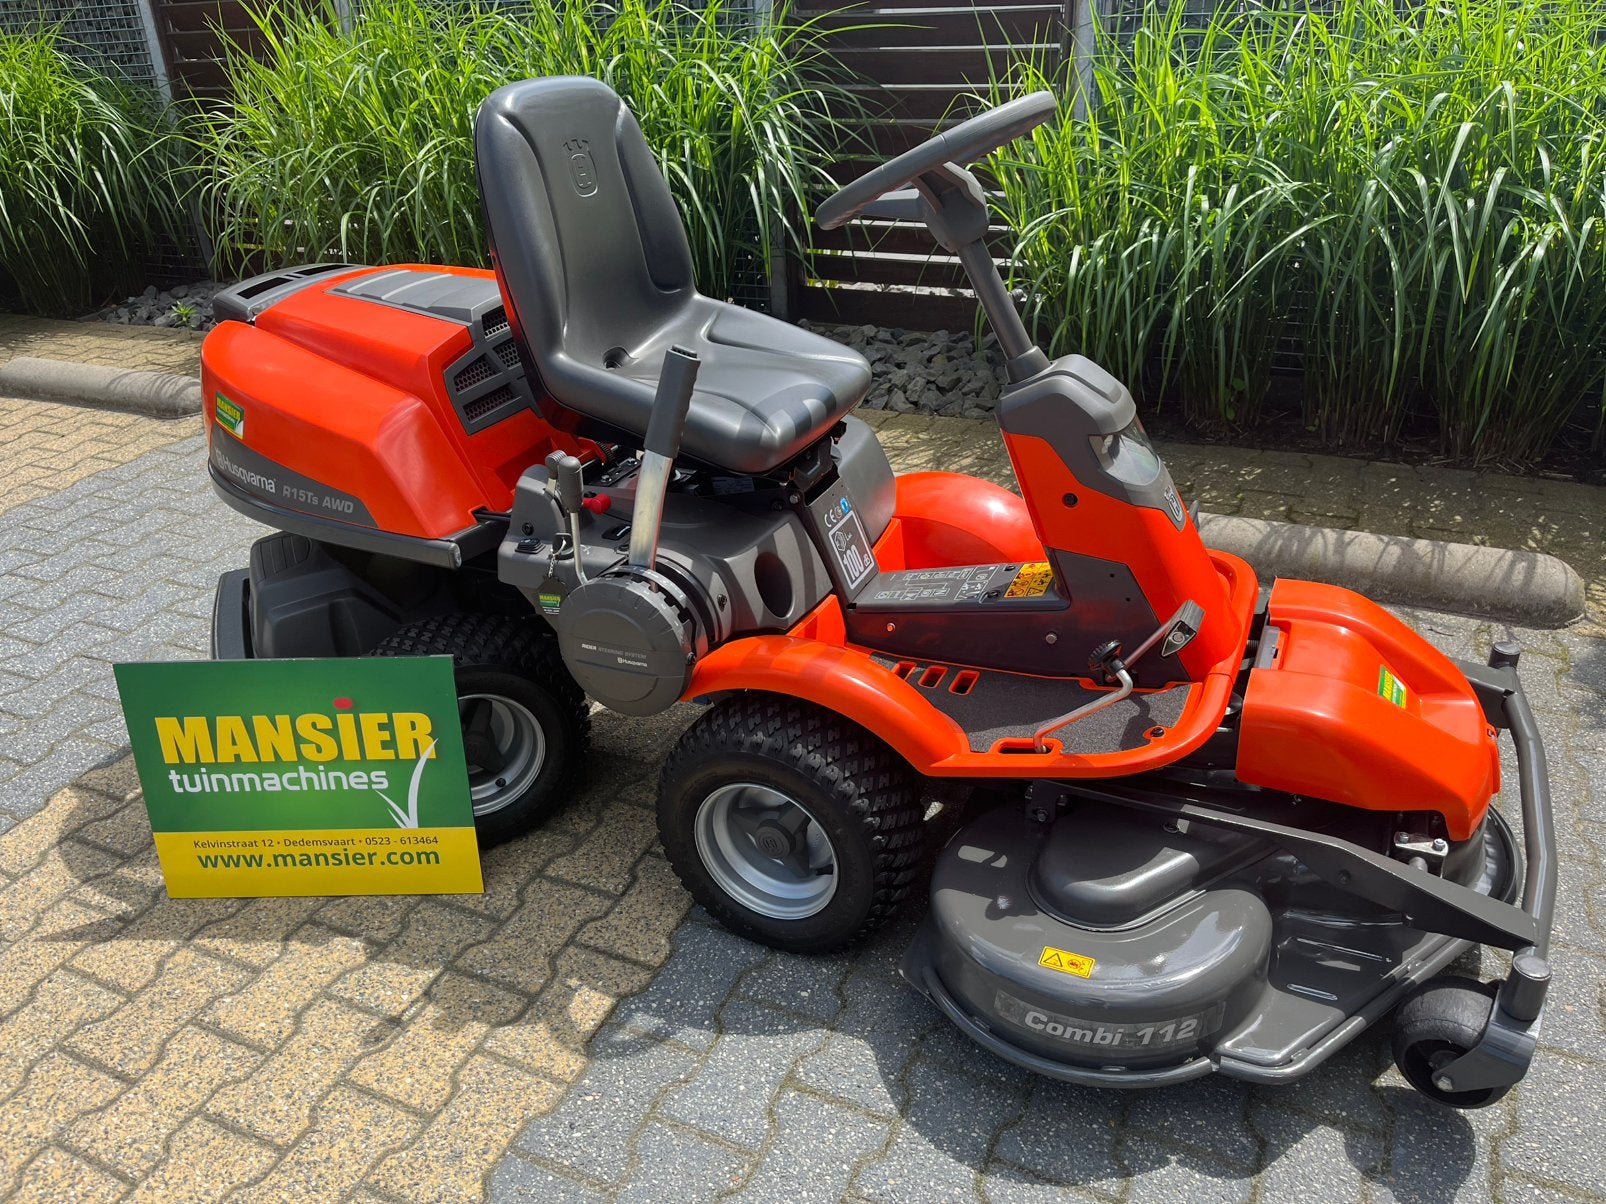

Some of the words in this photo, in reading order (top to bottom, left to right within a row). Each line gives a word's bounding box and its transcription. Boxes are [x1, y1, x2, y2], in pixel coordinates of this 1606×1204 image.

[222, 457, 276, 493] Husqvarna
[282, 485, 319, 505] R15Ts
[322, 496, 354, 514] AWD
[843, 545, 864, 580] 100
[154, 697, 437, 764] MANSIER
[168, 765, 389, 793] tuinmachines
[193, 838, 259, 849] Kelvinstraat
[261, 838, 275, 848] 12
[283, 836, 356, 848] Dedemsvaart
[365, 836, 391, 846] 0523
[399, 835, 439, 846] 613464
[197, 848, 441, 869] www.mansier.com
[1024, 1011, 1124, 1045] Combi
[1135, 1018, 1198, 1045] 112
